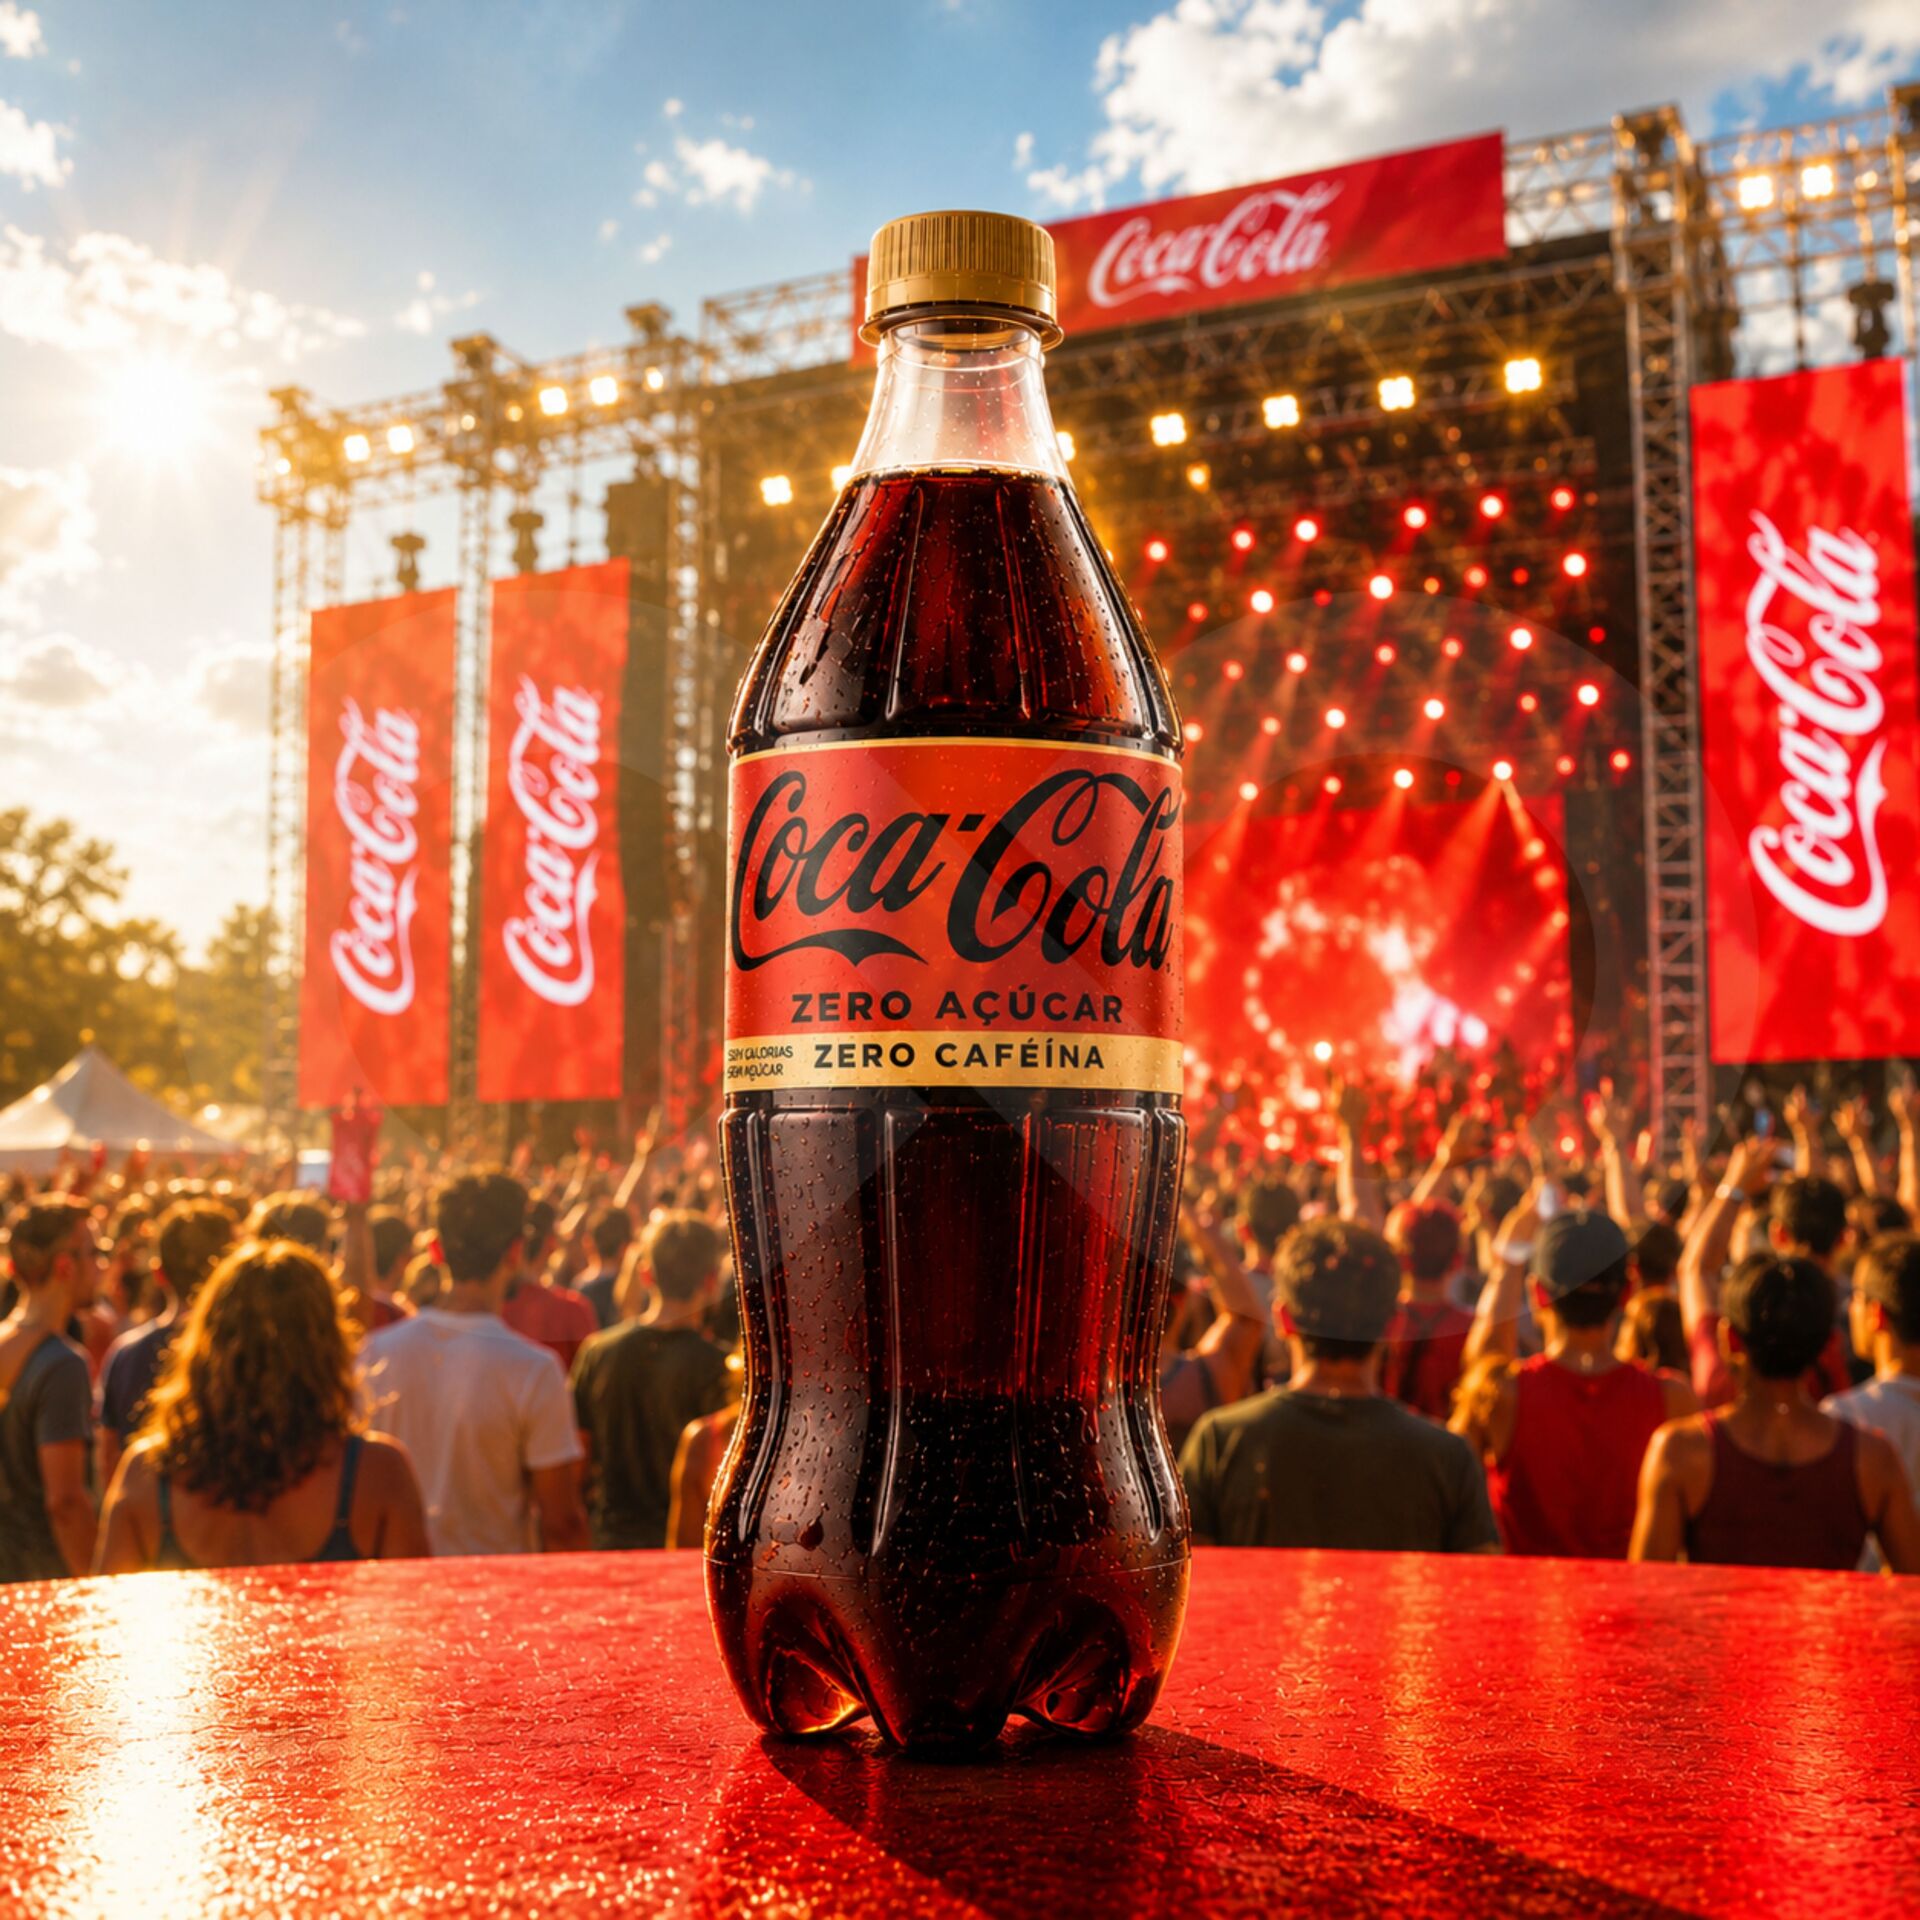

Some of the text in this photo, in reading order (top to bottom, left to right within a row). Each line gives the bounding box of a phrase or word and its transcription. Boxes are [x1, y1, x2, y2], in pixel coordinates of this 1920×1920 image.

[502, 673, 604, 1007] Coca-Cola
[1746, 508, 1889, 937] Coca-Cola
[331, 695, 421, 1016] Coca-Cola
[730, 769, 1182, 972] Coca-Cola
[791, 984, 1123, 1026] ZERO AÇÚCAR
[814, 1037, 1105, 1069] ZERO CAFÉÍNA
